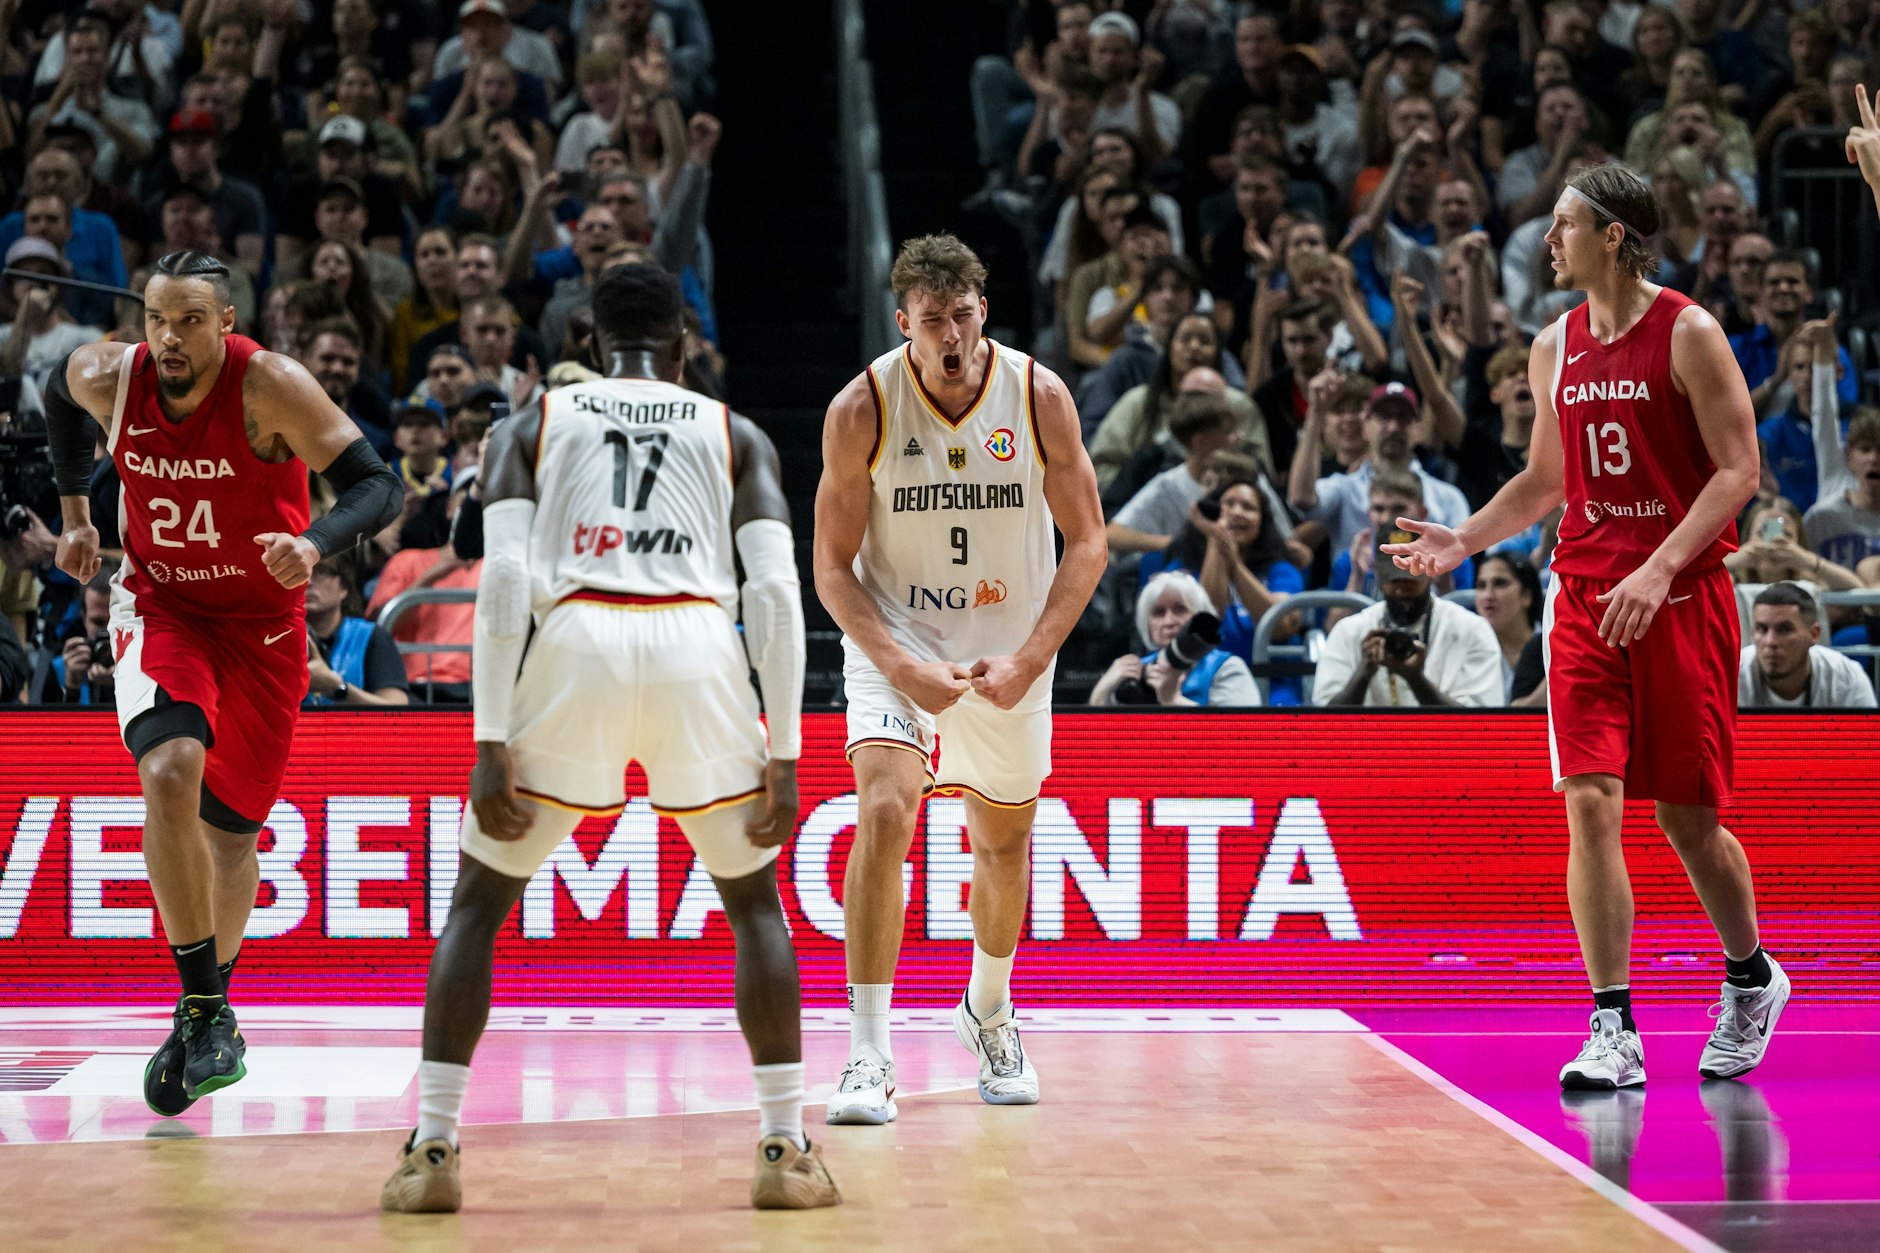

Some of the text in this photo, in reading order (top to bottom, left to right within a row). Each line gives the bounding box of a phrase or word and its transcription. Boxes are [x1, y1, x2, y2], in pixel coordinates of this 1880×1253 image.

[1563, 380, 1651, 406] CANADA
[904, 448, 925, 456] PEAK
[1586, 422, 1632, 478] 13
[124, 450, 236, 481] CANADA
[603, 429, 669, 512] 17
[893, 483, 1024, 513] DEUTSCHLAND
[1603, 499, 1666, 517] Sun Life
[148, 497, 221, 548] 24
[950, 526, 968, 566] 9
[175, 564, 247, 582] Sun Life
[907, 584, 968, 611] ING
[882, 713, 915, 738] ING
